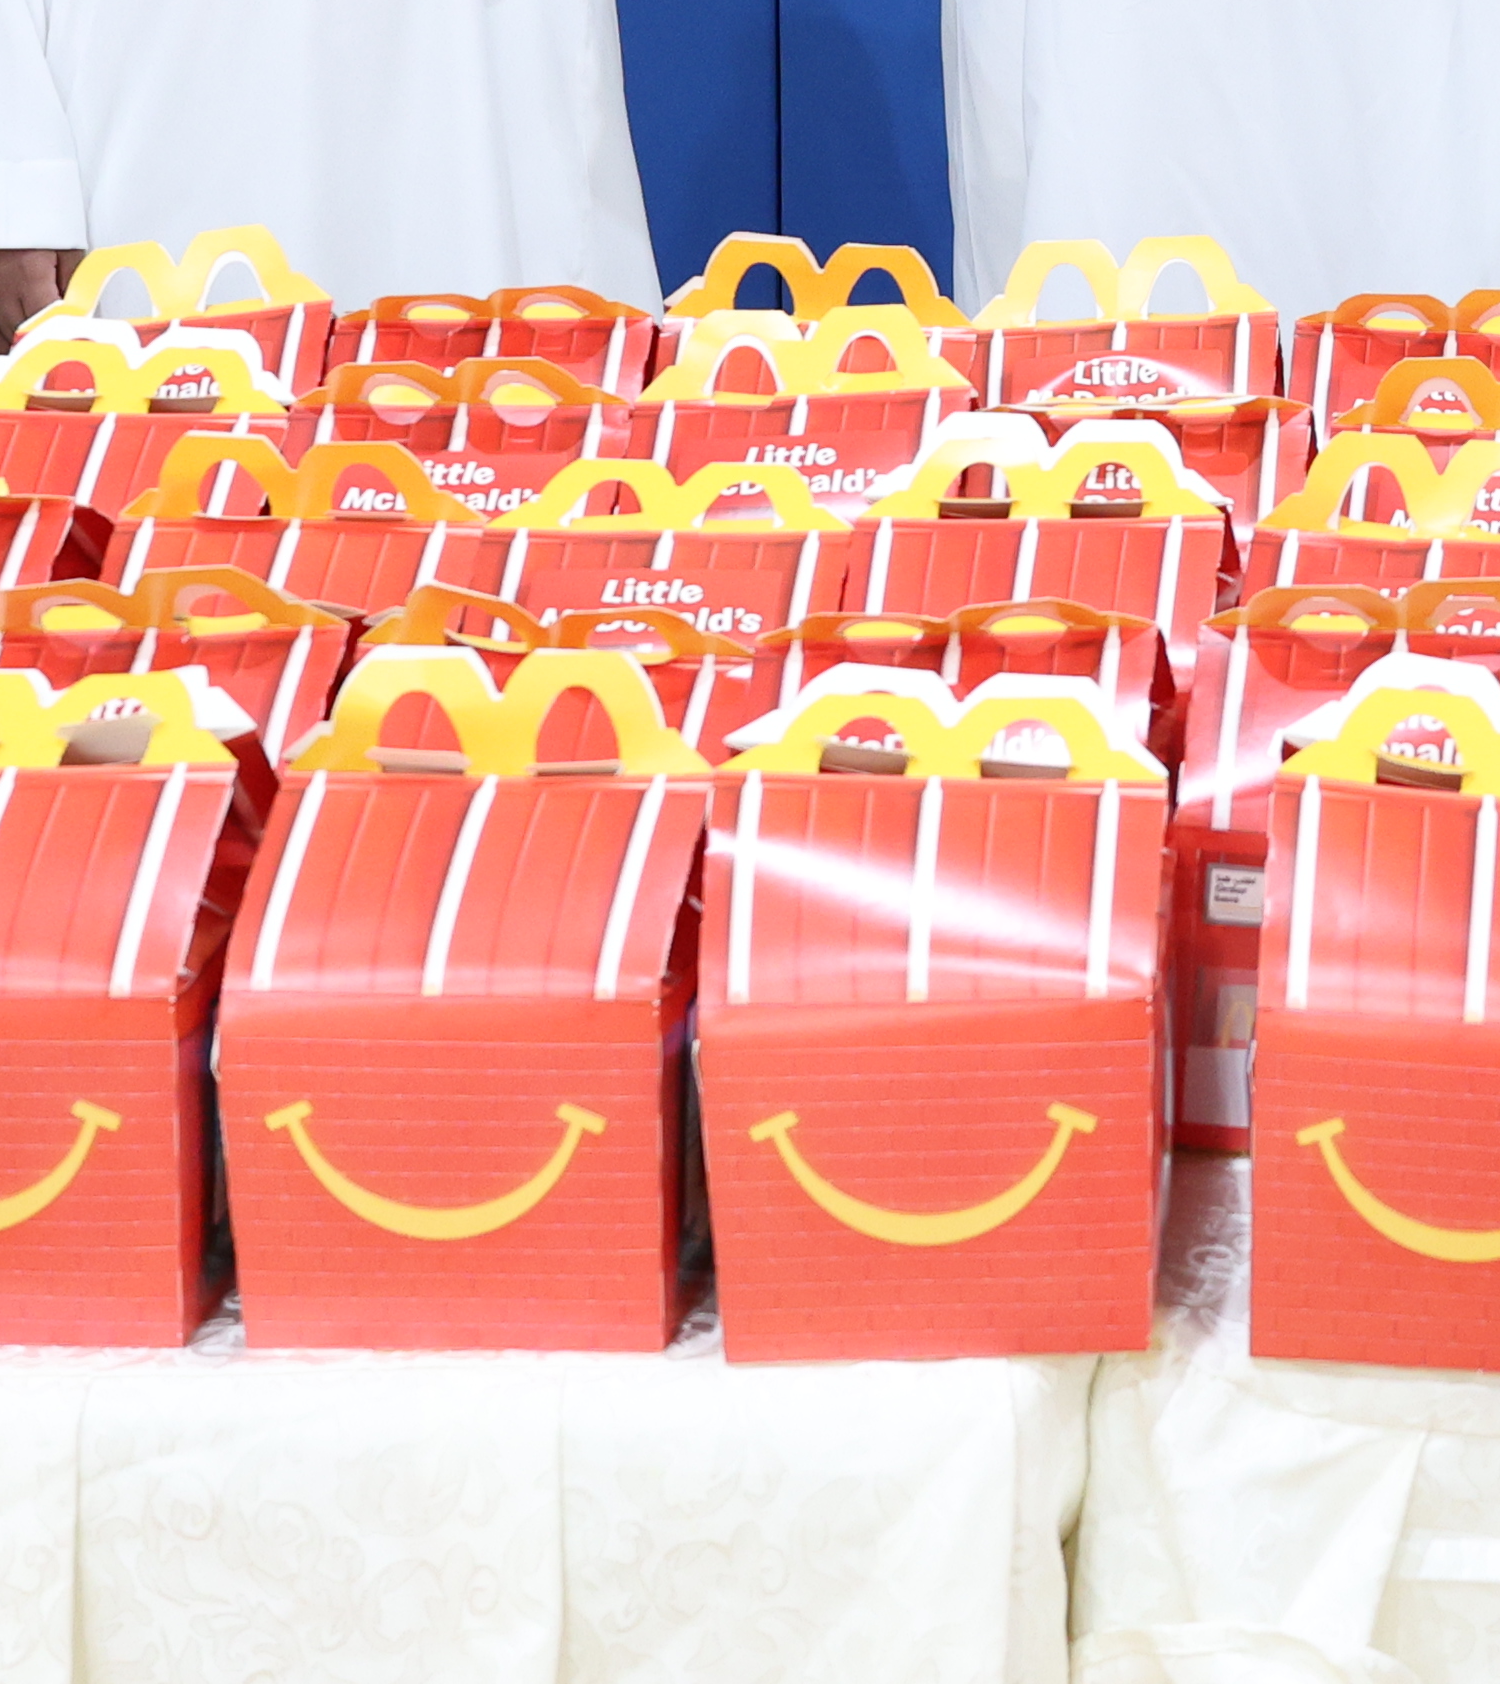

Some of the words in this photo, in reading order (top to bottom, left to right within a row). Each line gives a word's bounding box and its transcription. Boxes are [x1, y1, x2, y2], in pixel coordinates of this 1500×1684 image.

[1074, 359, 1159, 386] Little
[423, 460, 496, 486] ittle
[601, 577, 704, 605] Little
